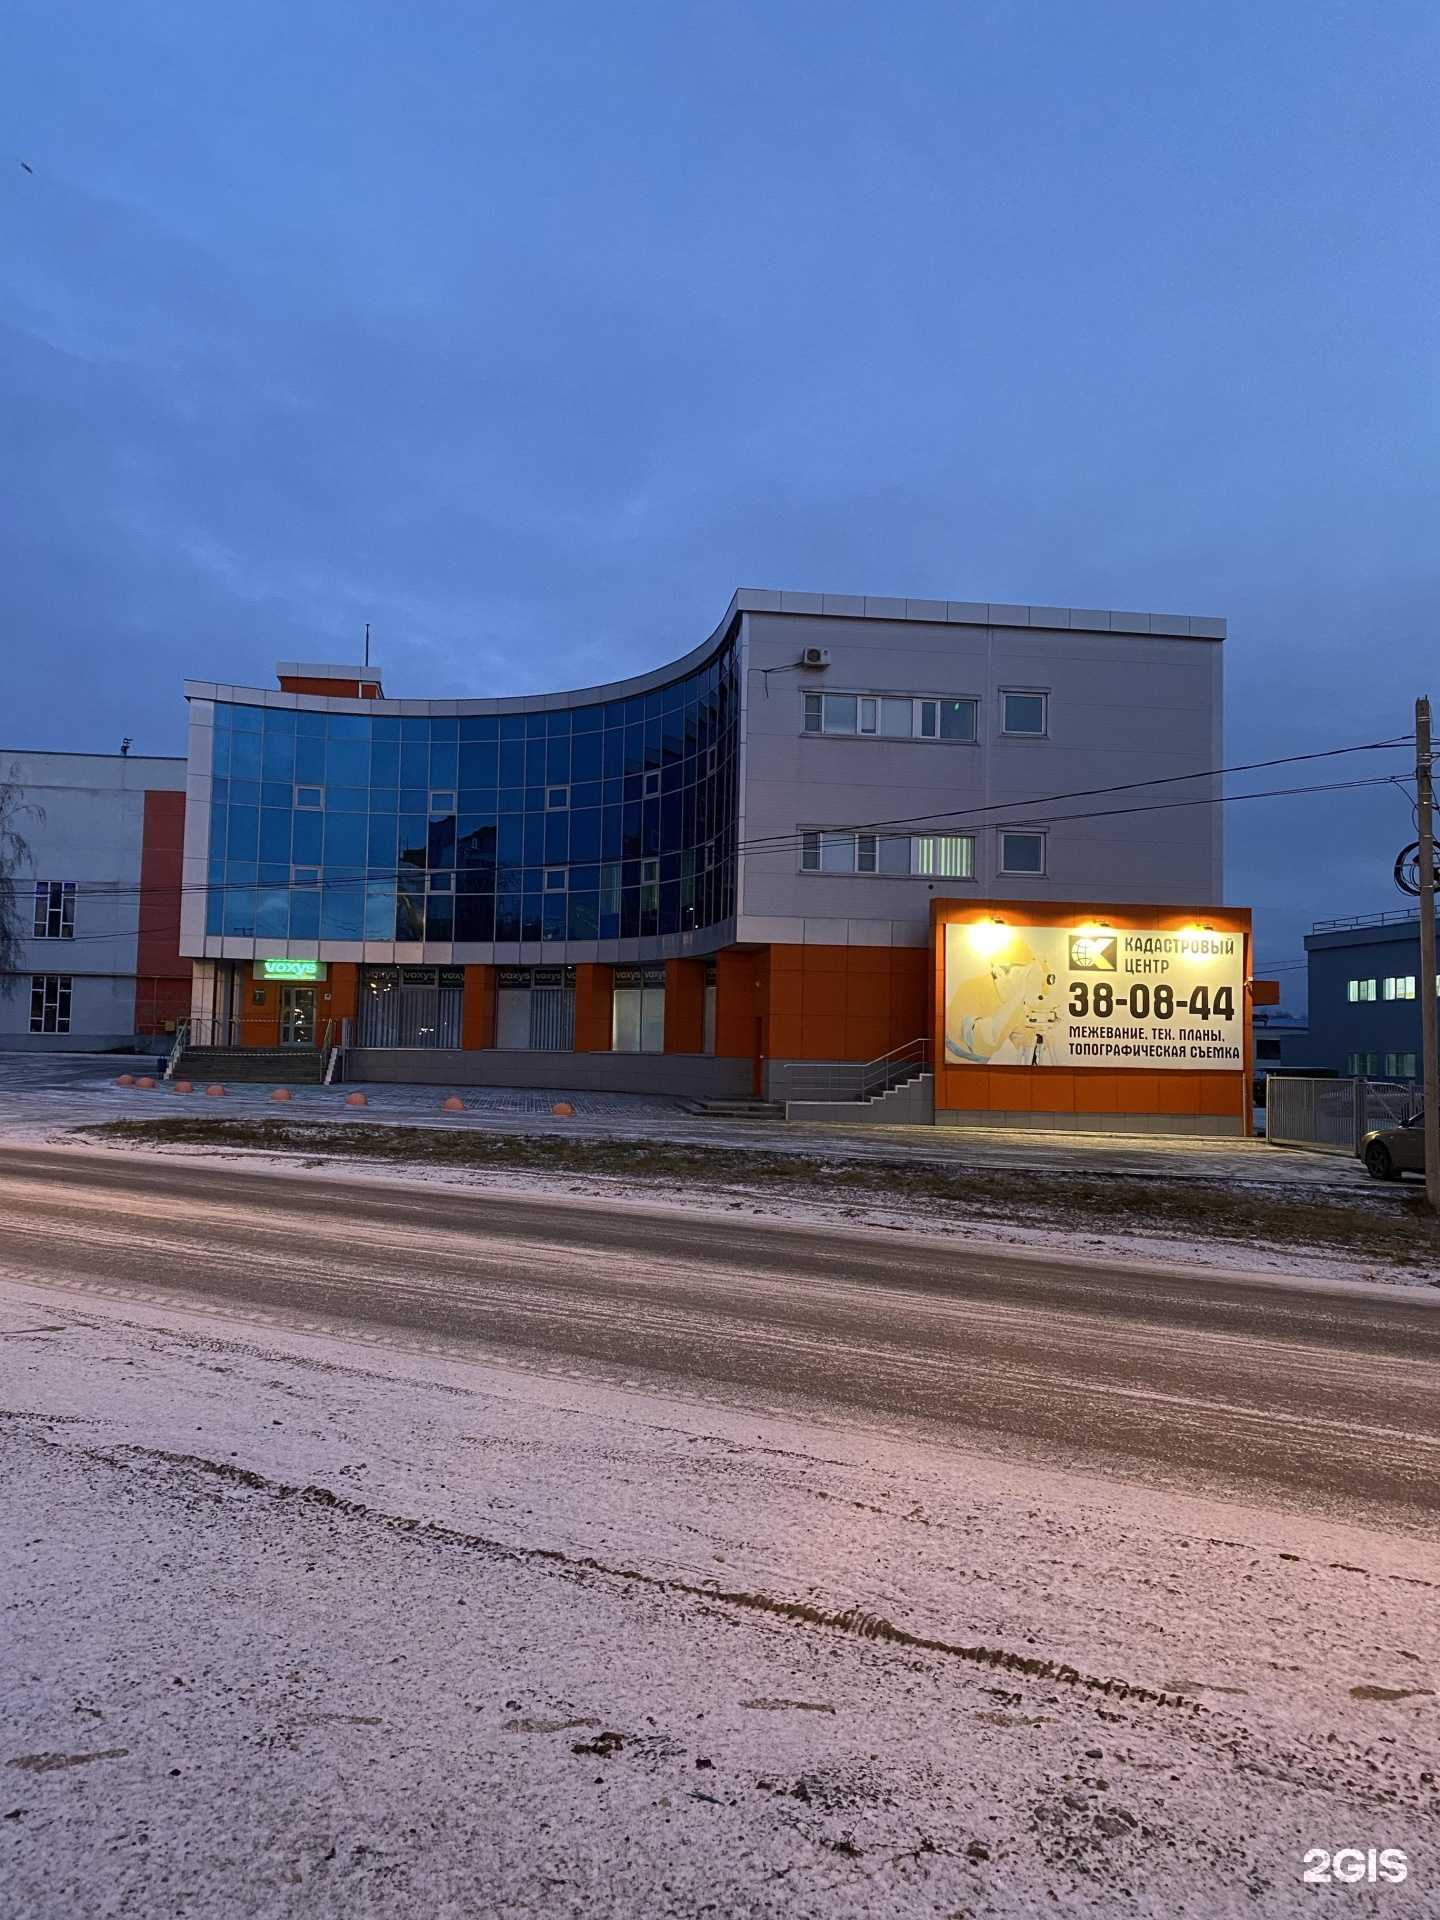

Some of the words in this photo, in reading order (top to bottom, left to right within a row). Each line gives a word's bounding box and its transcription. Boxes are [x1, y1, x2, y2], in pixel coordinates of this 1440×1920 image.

[1125, 936, 1234, 955] КАДАСТРОВЫЙ
[264, 960, 317, 976] voxys
[1125, 958, 1169, 974] ЦЕНТР
[1069, 981, 1235, 1021] 38-08-44
[1069, 1043, 1187, 1059] ТОПОГРАФИЧЕСКАЯ
[1190, 1046, 1240, 1060] СЪЕМКА
